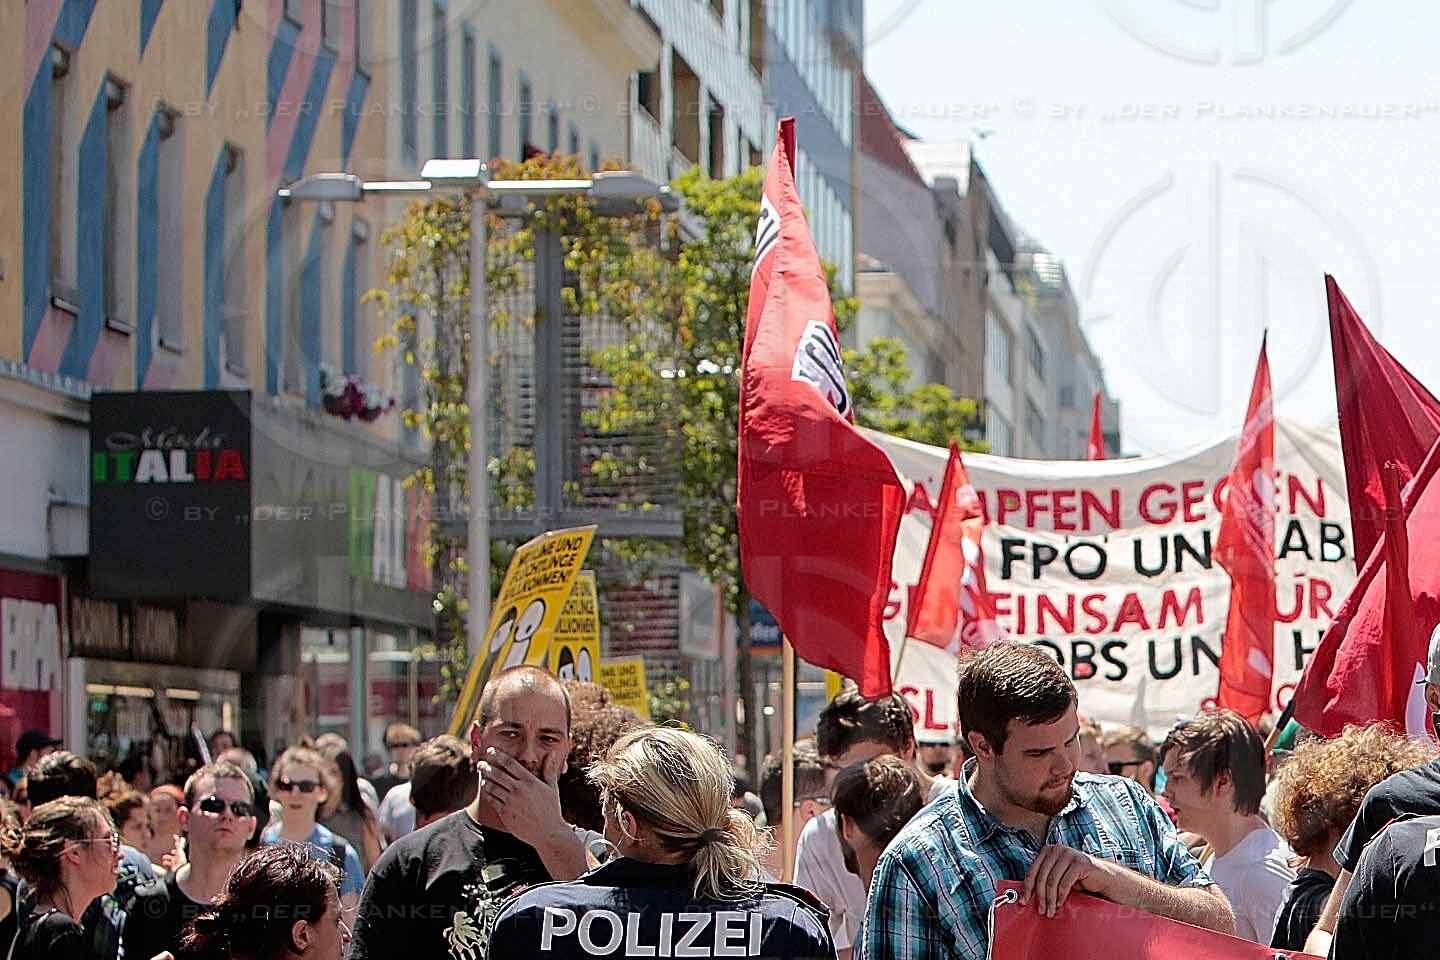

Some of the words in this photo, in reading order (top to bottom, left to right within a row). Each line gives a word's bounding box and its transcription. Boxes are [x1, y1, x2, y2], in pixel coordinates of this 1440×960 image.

[94, 449, 246, 483] ITALIA
[1001, 535, 1108, 581] FPÖ
[1134, 531, 1214, 577] UN
[1278, 519, 1347, 563] AB
[1274, 572, 1334, 623] ÜR
[1149, 634, 1223, 680] UN
[540, 906, 763, 958] POLIZEI
